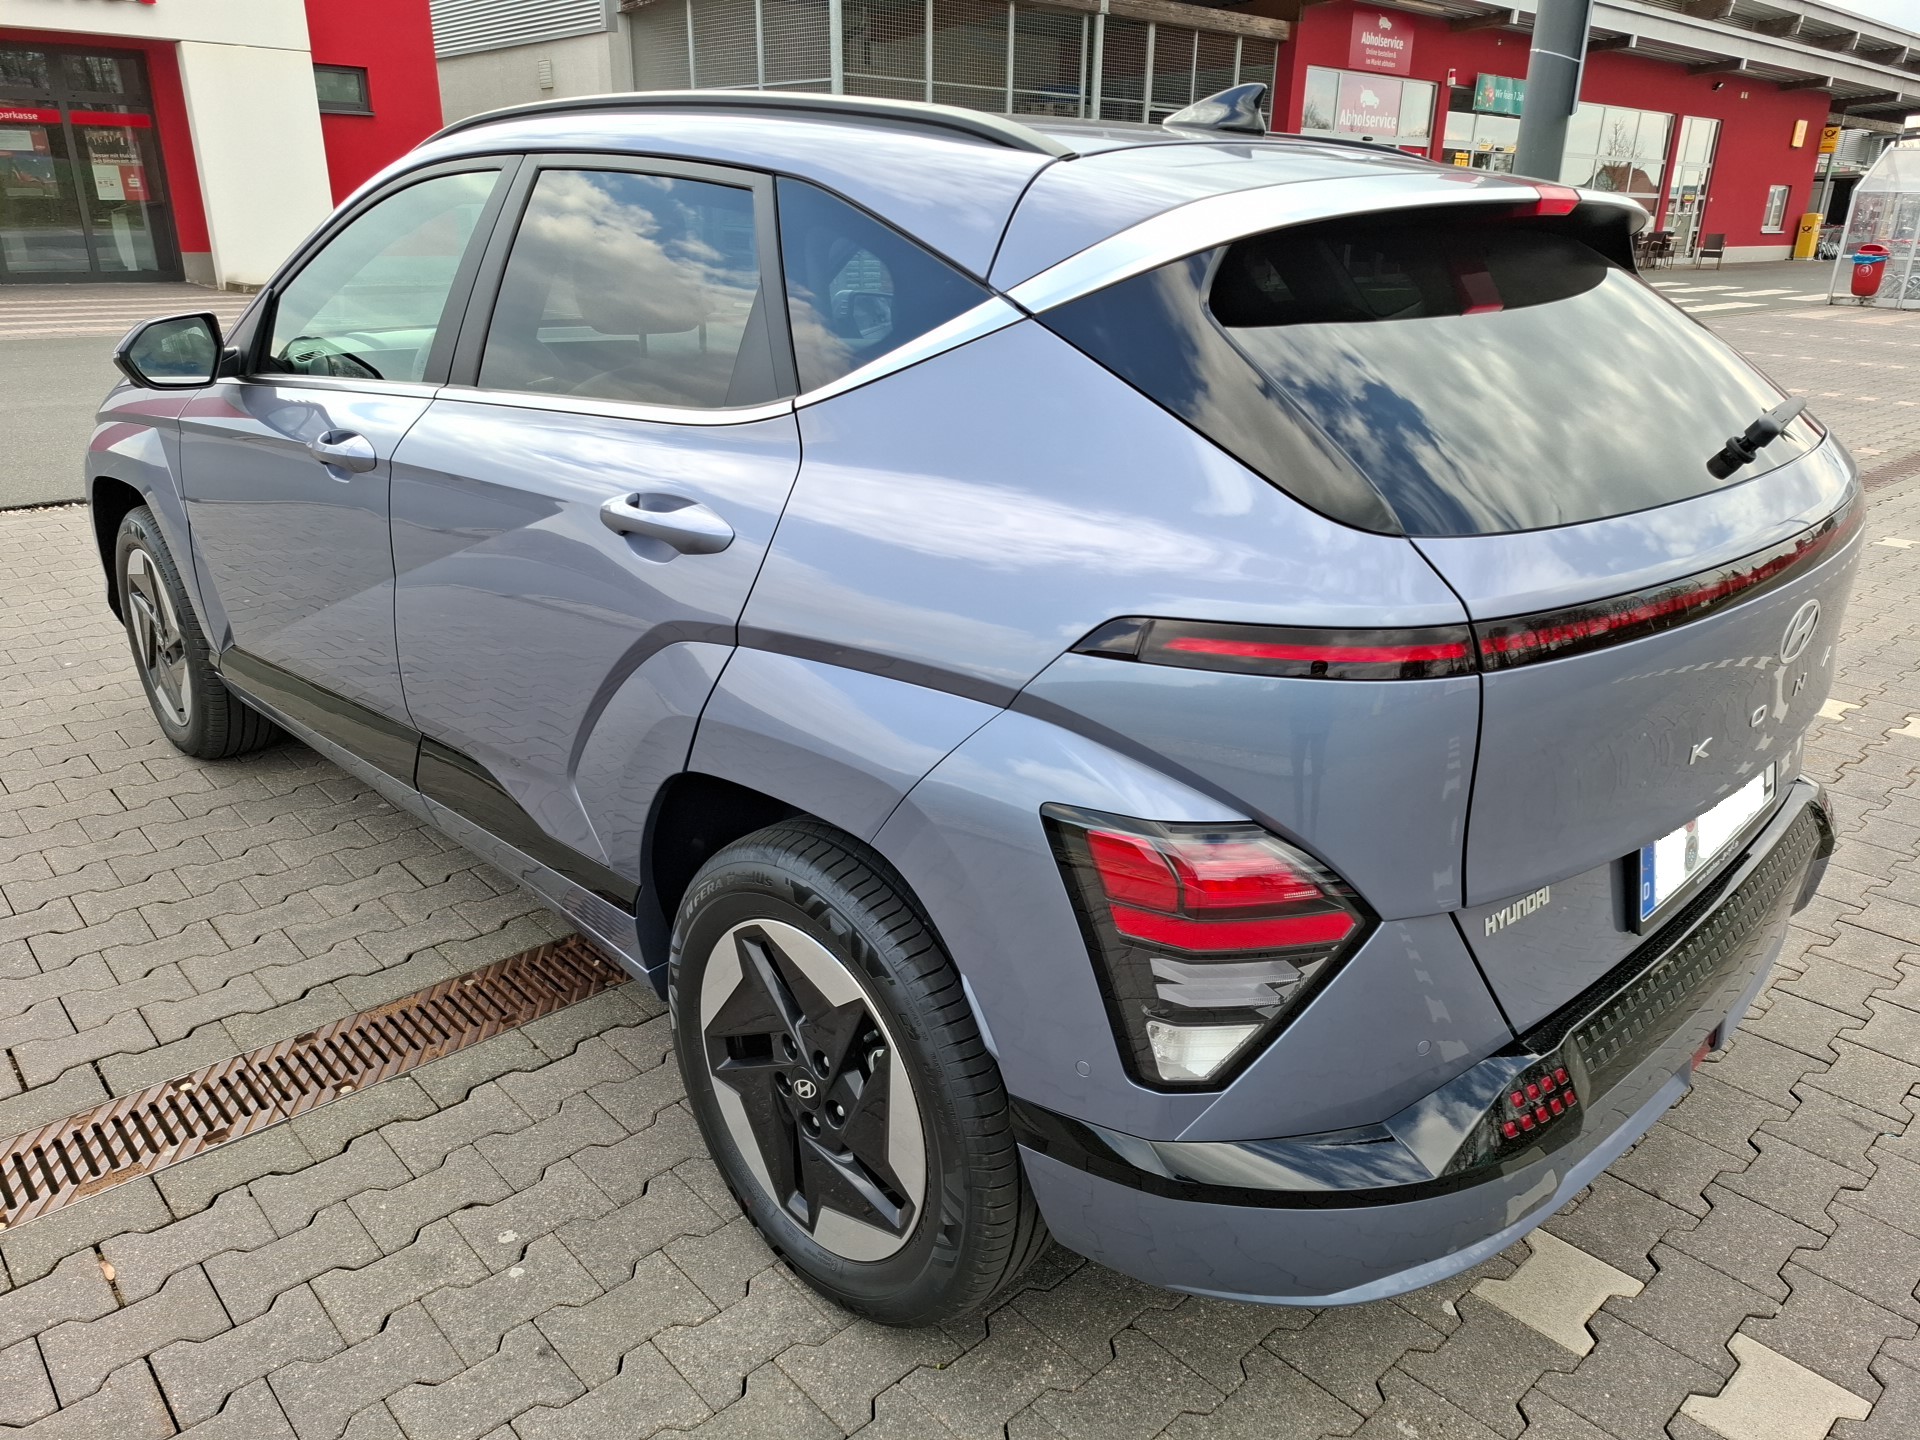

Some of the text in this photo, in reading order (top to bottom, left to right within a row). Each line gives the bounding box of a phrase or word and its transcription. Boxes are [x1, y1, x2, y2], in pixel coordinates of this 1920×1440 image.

[1361, 31, 1404, 50] Abholservice
[1339, 108, 1397, 129] Abholservice
[1643, 882, 1650, 900] D
[1484, 885, 1550, 937] HYUNDAI
